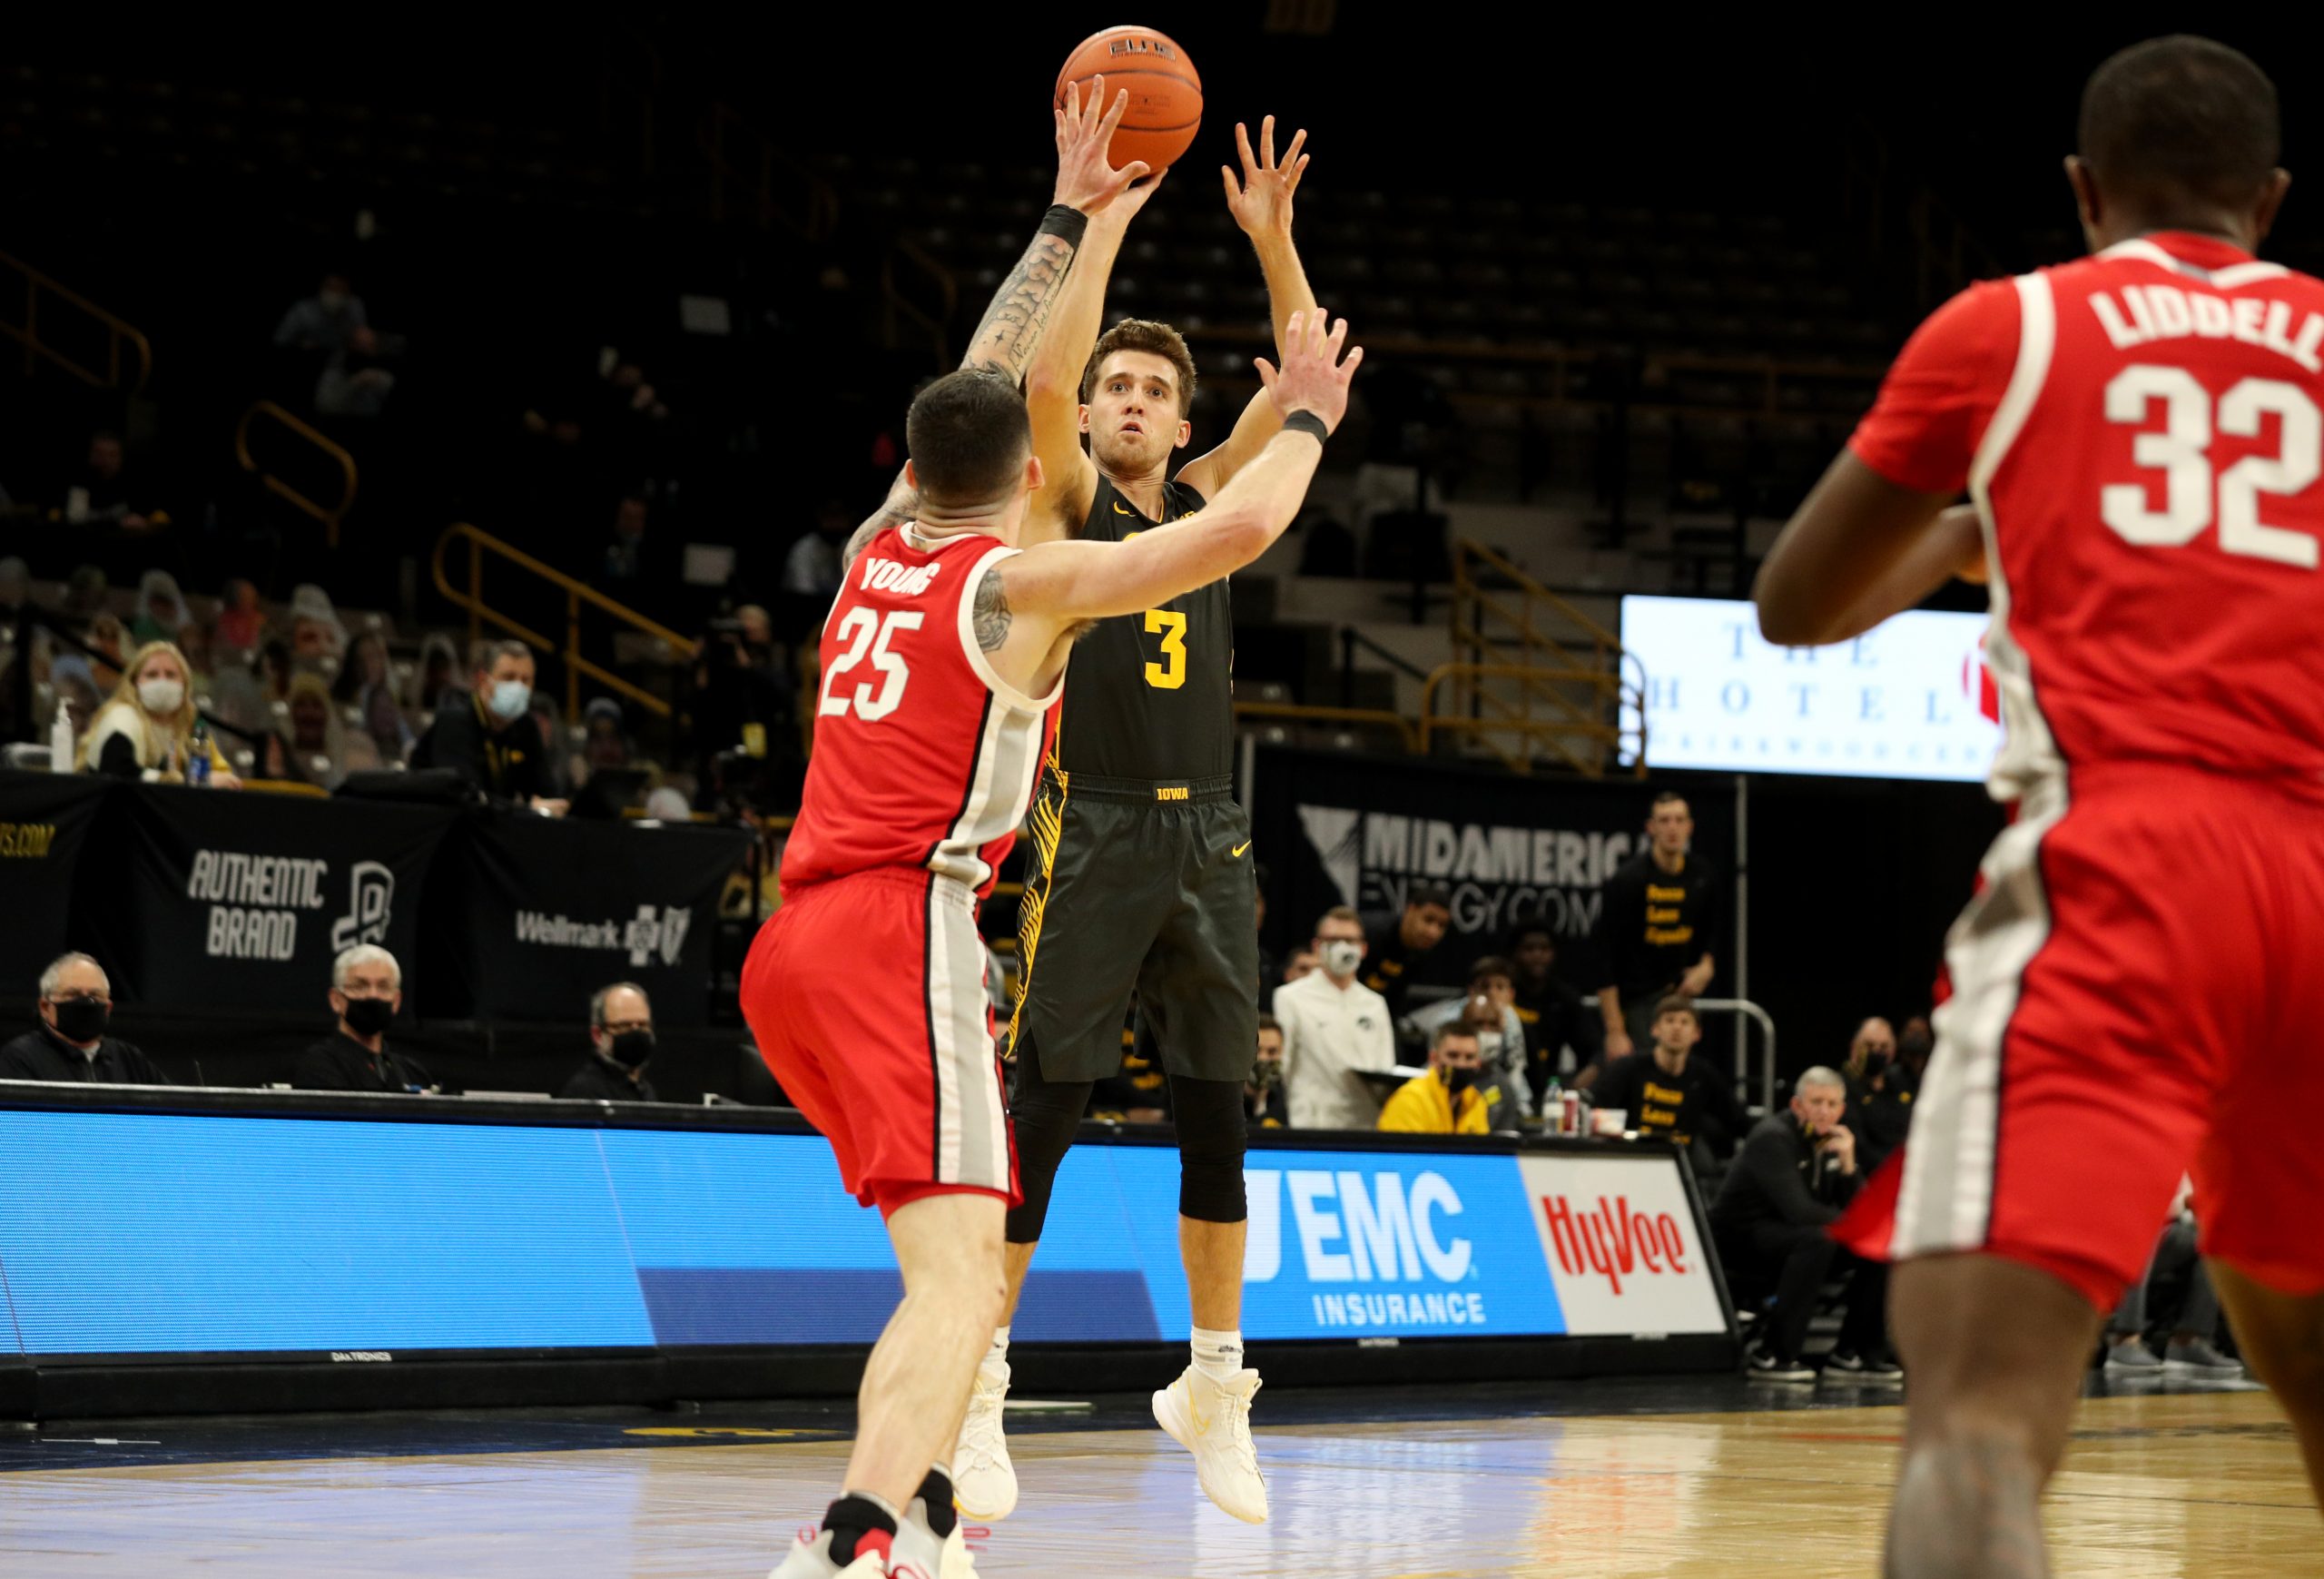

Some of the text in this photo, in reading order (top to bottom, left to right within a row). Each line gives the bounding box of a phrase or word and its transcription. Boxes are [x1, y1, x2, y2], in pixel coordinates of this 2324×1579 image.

[2088, 284, 2324, 374] LIDDELL
[2101, 362, 2324, 570] 32
[818, 605, 926, 722] 25
[1144, 608, 1187, 690] 3
[1650, 676, 1954, 725] HOTEL
[1156, 787, 1189, 801] IOWA
[187, 849, 329, 908] AUTHENTIC
[206, 905, 298, 961] BRAND
[516, 910, 619, 949] Wellmark
[1286, 1169, 1472, 1283] EMC
[1313, 1292, 1486, 1326] INSURANCE
